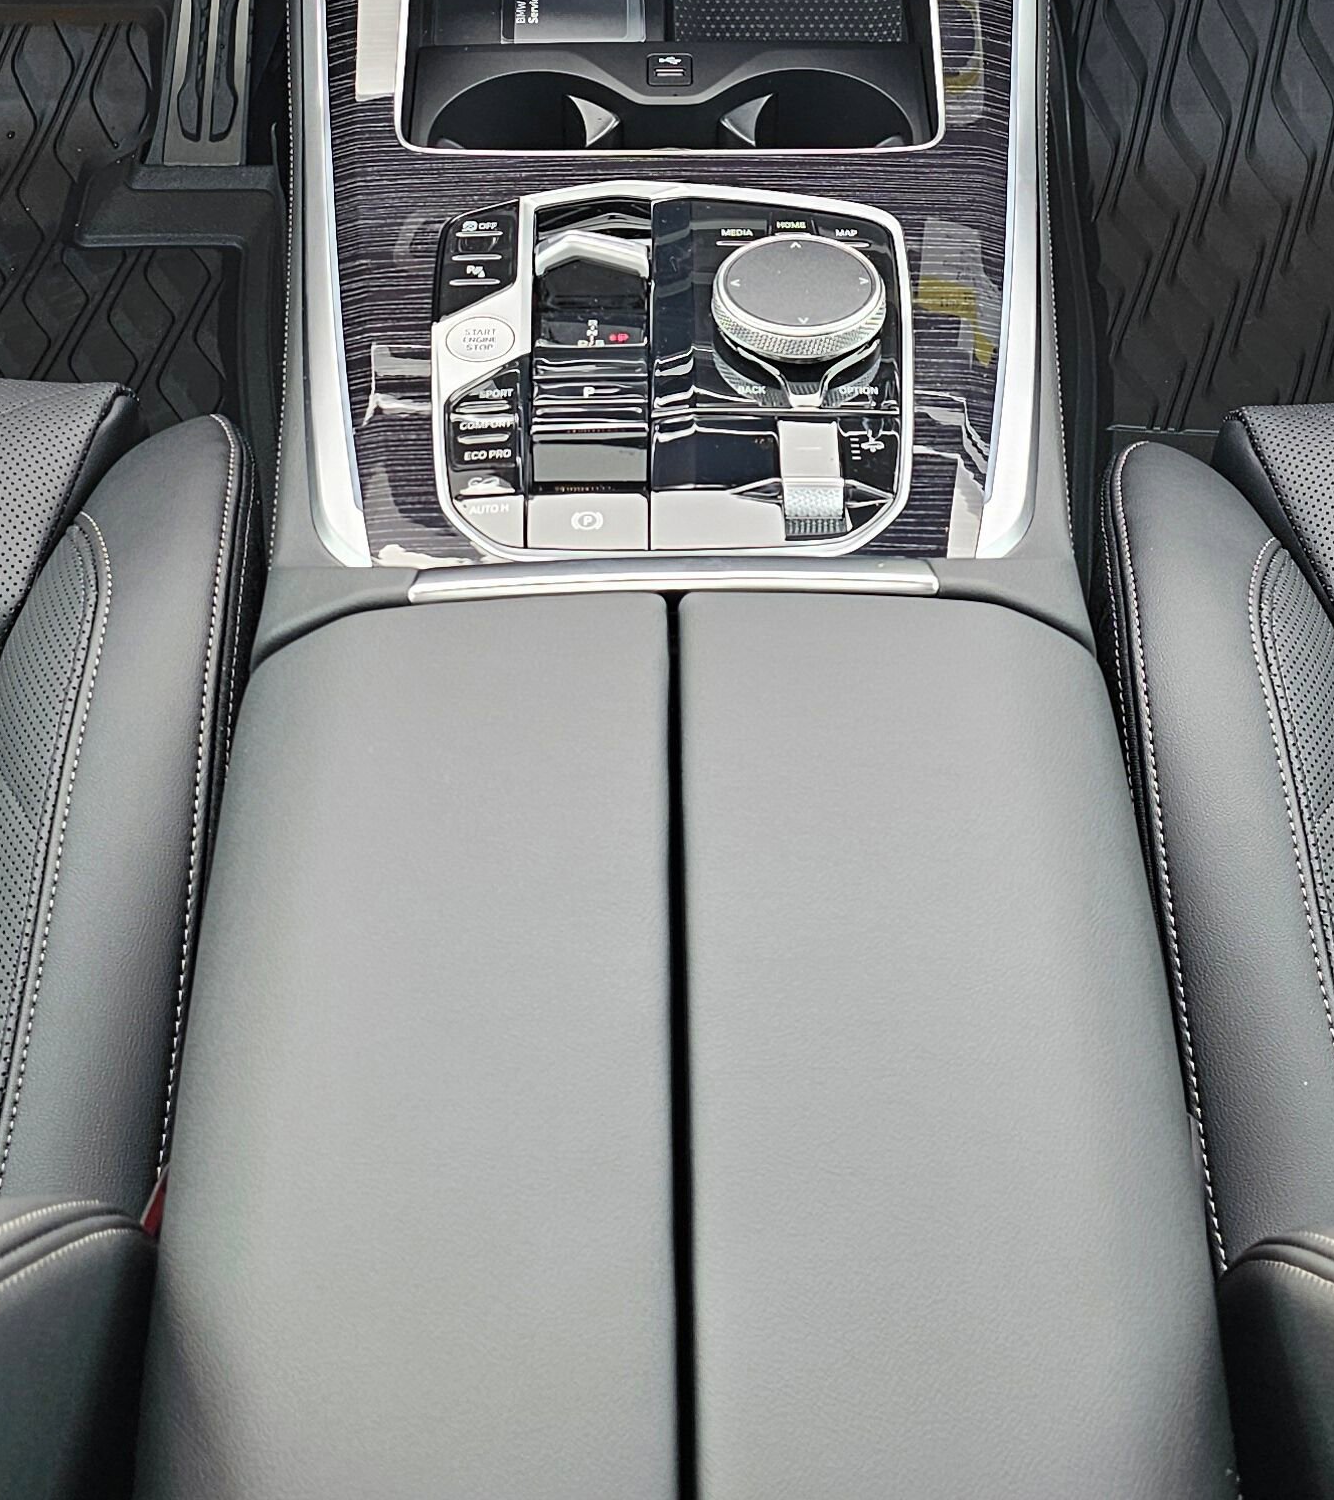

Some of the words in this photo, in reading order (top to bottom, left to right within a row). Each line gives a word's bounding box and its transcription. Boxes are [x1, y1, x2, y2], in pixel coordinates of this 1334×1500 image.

[516, 1, 526, 23] BMW
[776, 221, 807, 229] HOME
[720, 228, 754, 237] MEDIA
[835, 228, 858, 237] MAP
[479, 388, 514, 399] SPORT
[583, 386, 595, 398] P
[738, 385, 766, 394] BACK
[838, 386, 879, 396] OPTION
[464, 450, 487, 461] ECO
[489, 449, 512, 459] PRO
[469, 504, 499, 515] AUTO
[500, 503, 509, 513] H
